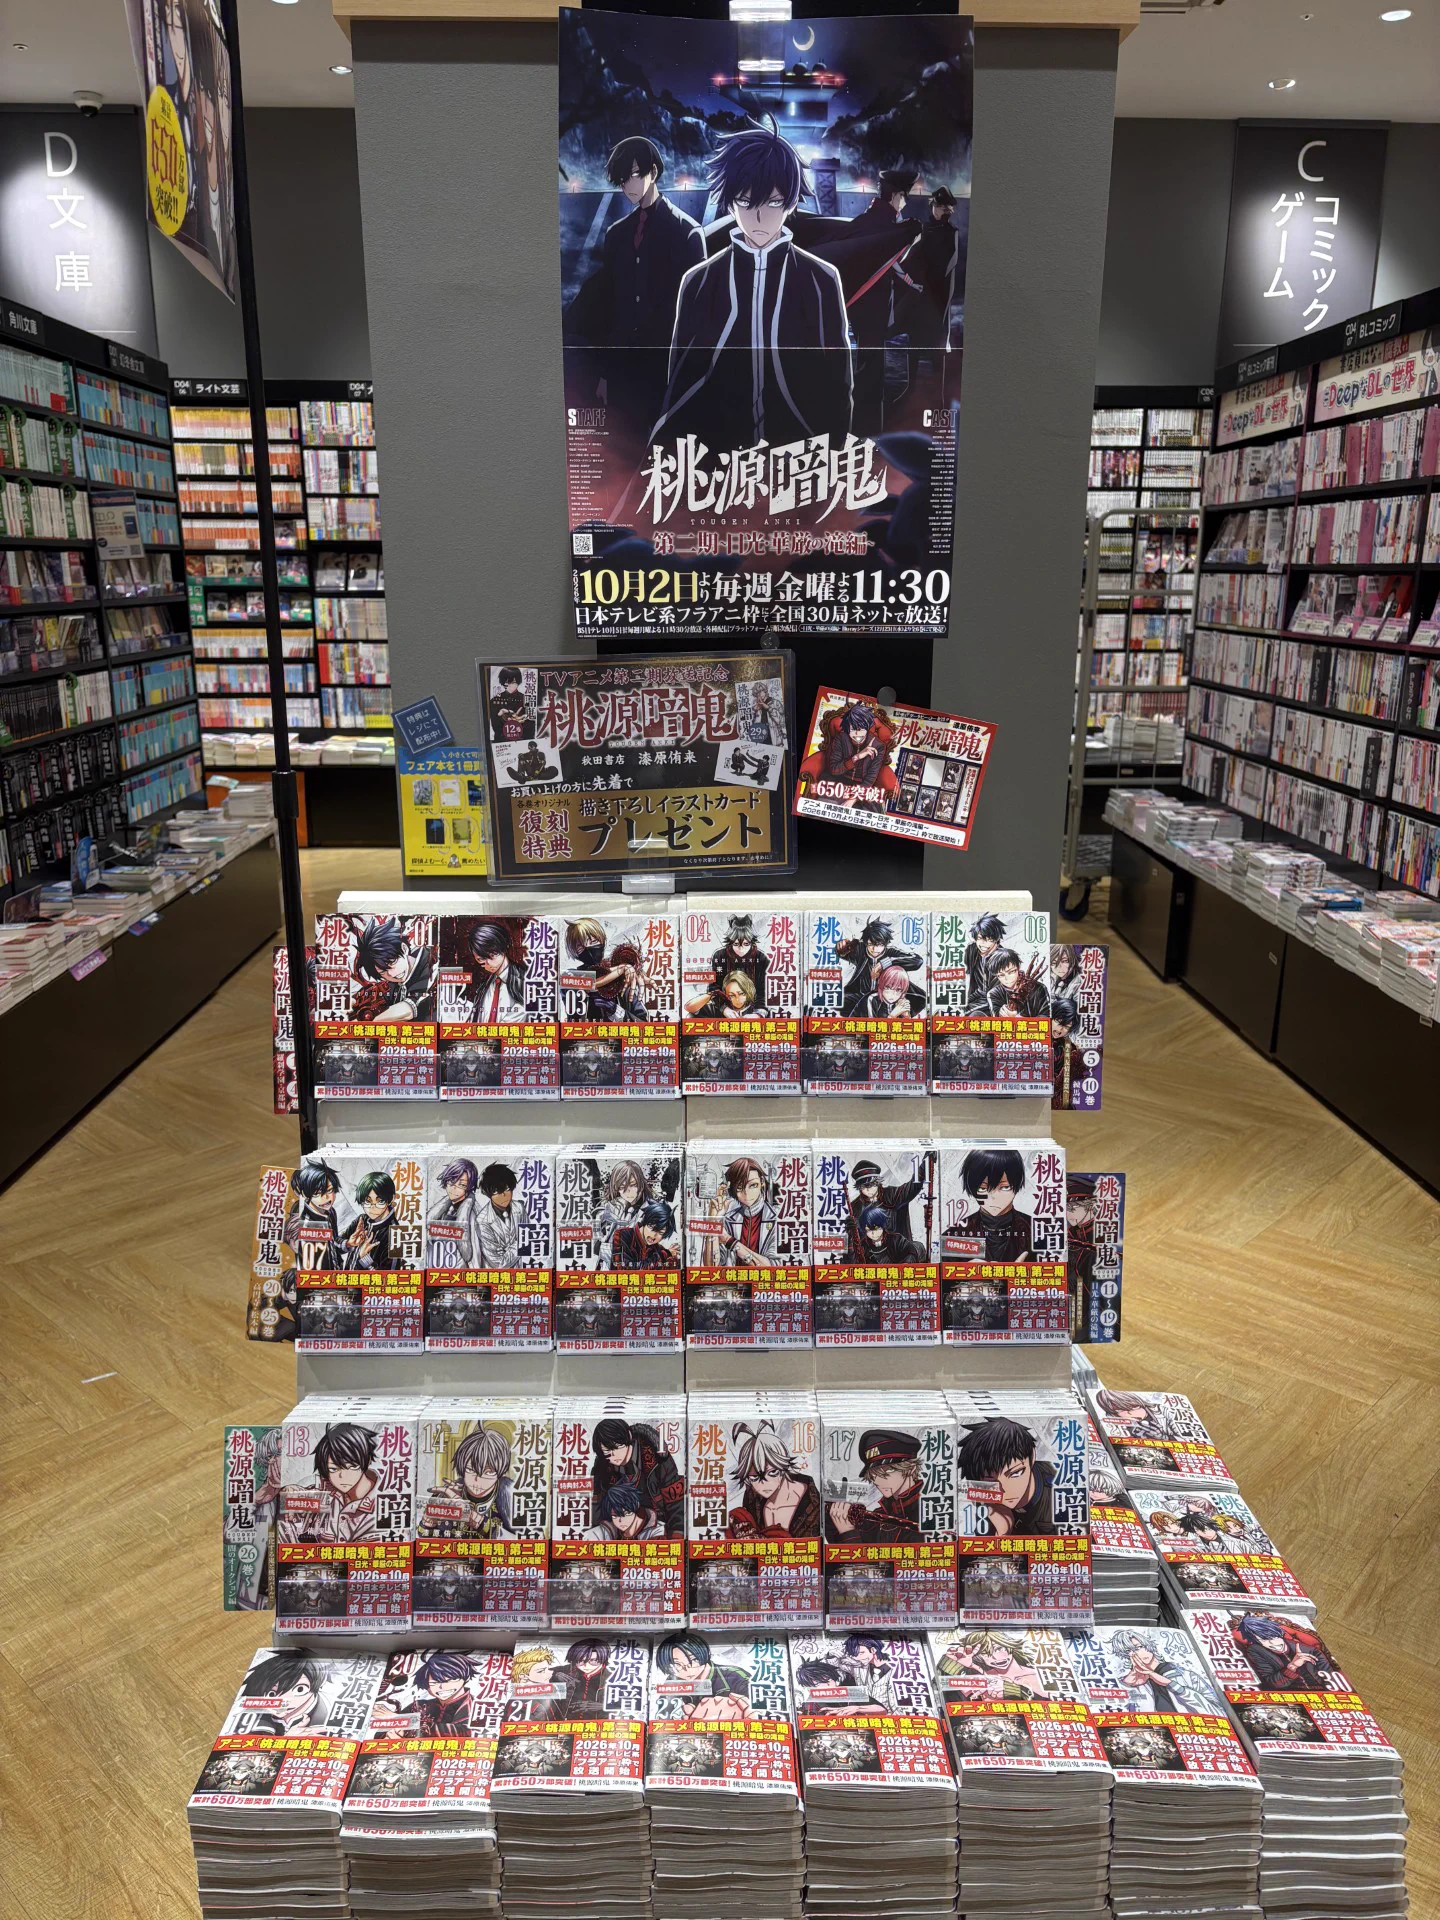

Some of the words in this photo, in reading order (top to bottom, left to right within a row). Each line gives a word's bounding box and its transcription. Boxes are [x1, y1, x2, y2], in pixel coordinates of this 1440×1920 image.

[44, 132, 78, 178] D
[1298, 140, 1327, 182] C
[46, 187, 93, 292] 文庫
[1264, 191, 1305, 299] ゲーム
[1303, 197, 1340, 331] コミック
[195, 384, 240, 394] ライト文芸
[567, 408, 606, 426] STAFF
[923, 409, 957, 427] CAST
[636, 432, 888, 524] 桃源暗鬼
[690, 518, 748, 526] TOUGEN
[764, 518, 801, 526] ANKI
[540, 664, 730, 687] TVアニメ第二期放送記念
[537, 683, 741, 749] 桃源暗鬼
[897, 719, 984, 762] 桃源暗鬼
[582, 755, 625, 765] 秋田書店
[511, 774, 634, 798] お買い上げの方に先着で
[516, 799, 571, 808] 各巻オリジナル
[579, 791, 762, 817] 描き下ろしイラストカード
[519, 809, 570, 834] 復刻
[578, 812, 763, 856] プレゼント
[521, 834, 573, 859] 特典
[413, 920, 434, 948] 01
[685, 915, 711, 942] 04
[902, 917, 924, 945] 05
[1024, 915, 1047, 943] 06
[565, 990, 587, 1016] 03
[1079, 948, 1104, 1037] 桃源暗鬼
[380, 1046, 434, 1058] 2026年10月
[745, 1043, 797, 1054] 2026年10月
[996, 1042, 1048, 1053] 2026年10月
[912, 1155, 931, 1184] 11
[257, 1171, 288, 1265] 桃源暗鬼
[946, 1199, 969, 1228] 12
[1095, 1176, 1120, 1269] 桃源暗鬼
[301, 1242, 328, 1270] 07
[431, 1241, 457, 1269] 08
[364, 1296, 420, 1308] 2026年10月
[285, 1425, 310, 1457] 13
[422, 1423, 446, 1454] 14
[656, 1422, 680, 1454] 15
[792, 1421, 816, 1454] 16
[830, 1430, 856, 1461] 17
[228, 1430, 255, 1530] 桃源暗鬼
[963, 1504, 990, 1536] 18
[350, 1570, 409, 1582] 2026年10月
[1030, 1563, 1088, 1575] 2026年10月
[389, 1654, 417, 1677] 20
[1318, 1671, 1351, 1692] 30
[509, 1699, 532, 1721] 21
[655, 1695, 684, 1719] 22
[1310, 1710, 1375, 1721] 2026年10月
[225, 1711, 257, 1735] 19
[725, 1740, 790, 1753] 2026年10月
[878, 1736, 942, 1748] 2026年10月
[1175, 1733, 1239, 1748] 2026年10月
[284, 1758, 349, 1771] 2026年10月
